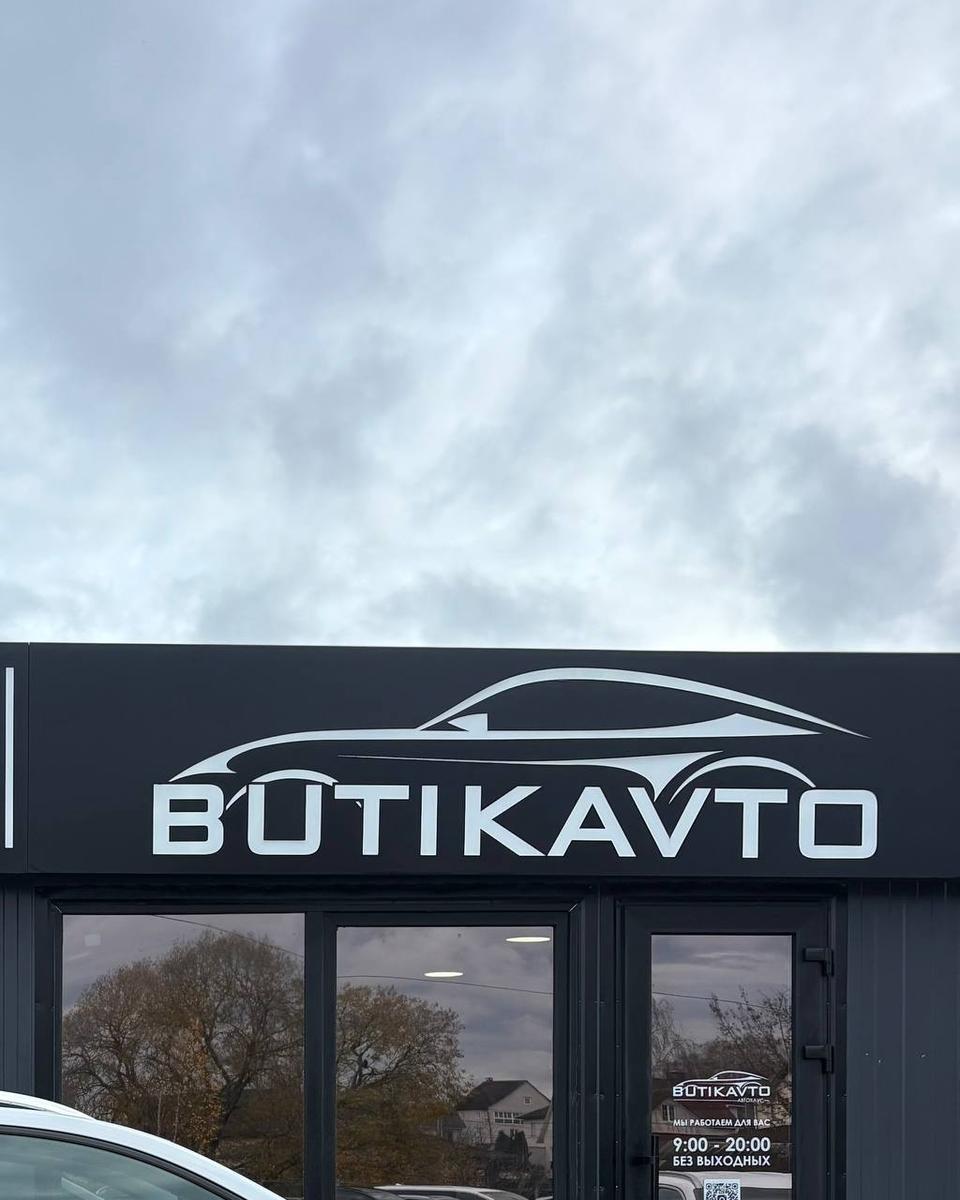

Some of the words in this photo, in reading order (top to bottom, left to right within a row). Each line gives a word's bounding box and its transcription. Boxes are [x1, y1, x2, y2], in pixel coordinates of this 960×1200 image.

[152, 783, 879, 860] BUTIKAVTO
[673, 1085, 771, 1097] BUTIKAVTO
[673, 1119, 688, 1127] МЫ
[690, 1119, 733, 1127] РАБОТАЕМ
[734, 1119, 752, 1127] ДЛЯ
[753, 1119, 771, 1127] ВАС
[673, 1137, 708, 1152] 9:00
[725, 1137, 771, 1152] 20:00
[673, 1155, 693, 1166] БЕЗ
[696, 1155, 771, 1167] ВЫХОДНЫХ
